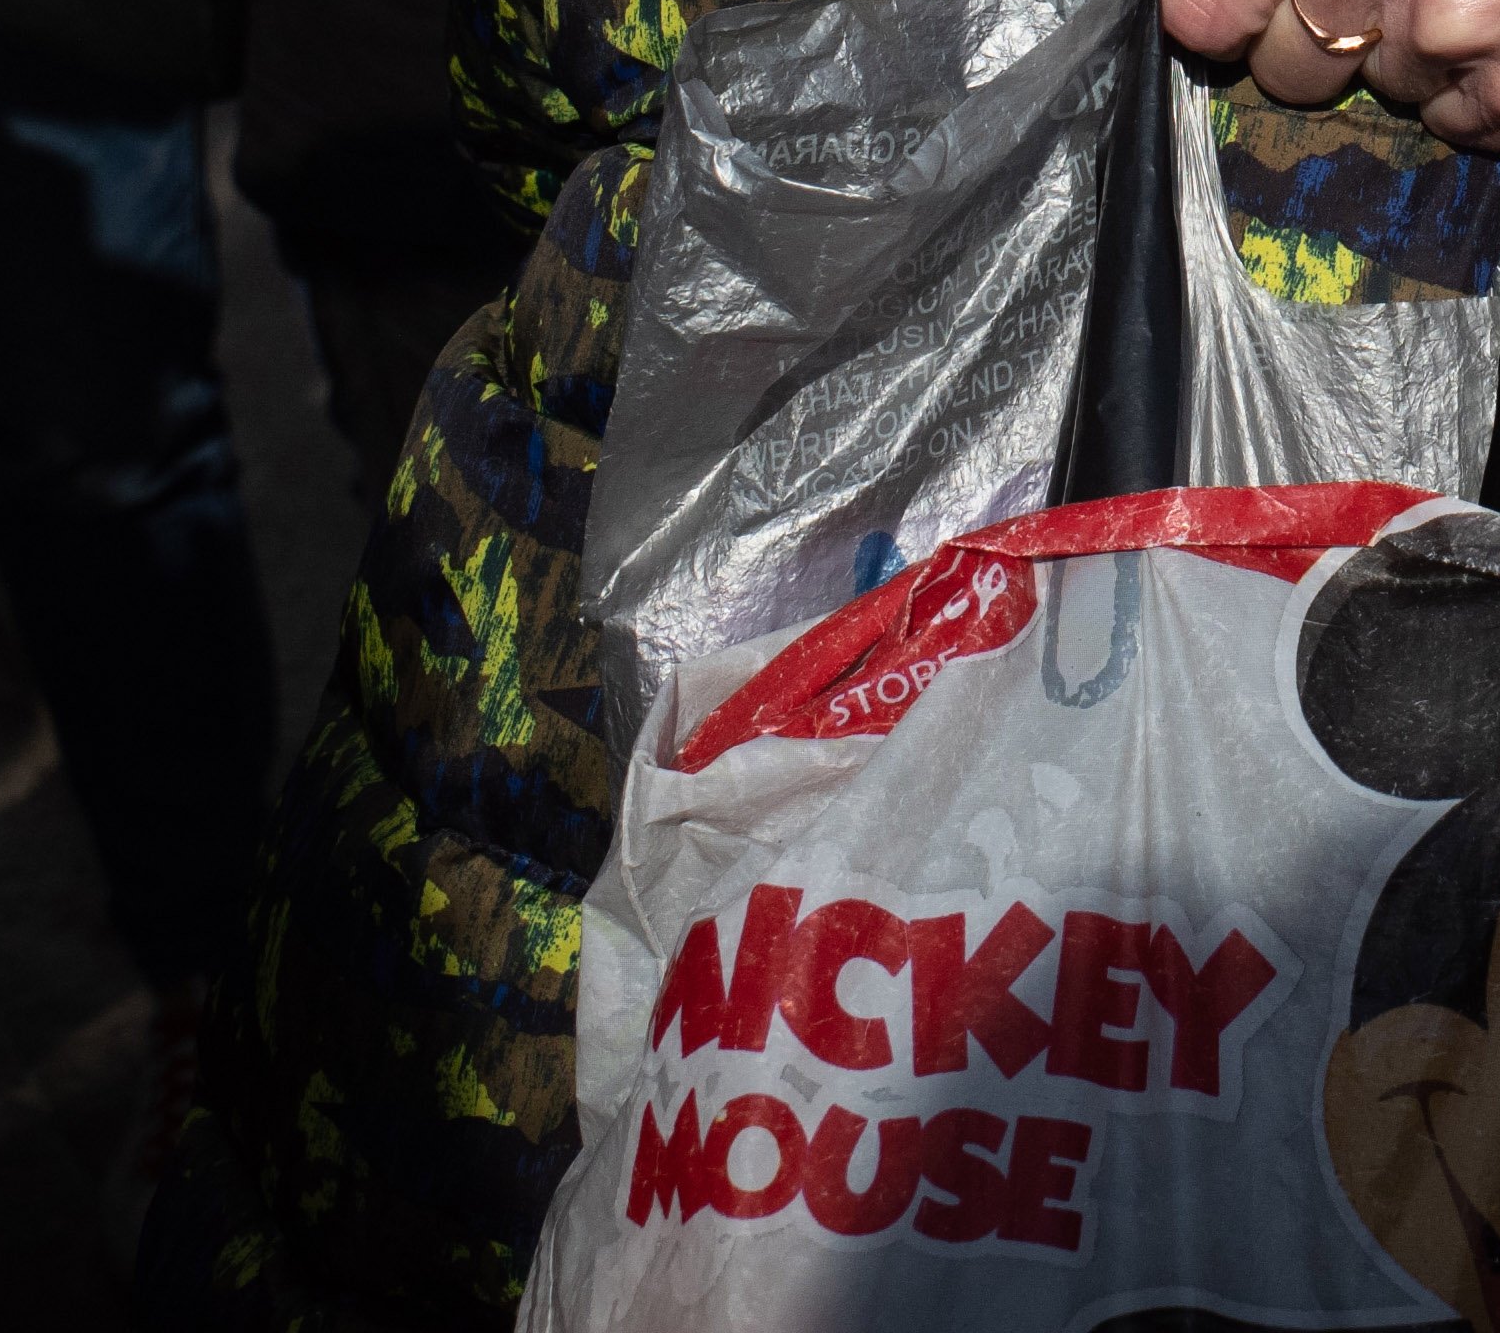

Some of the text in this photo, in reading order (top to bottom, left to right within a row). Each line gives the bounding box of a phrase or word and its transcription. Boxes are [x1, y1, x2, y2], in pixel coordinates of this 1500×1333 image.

[975, 195, 1096, 276] PROCES
[982, 238, 1093, 314] CHARAC
[999, 291, 1082, 346] CHAR
[929, 417, 972, 457] ON
[625, 1086, 1092, 1251] MOUSE
